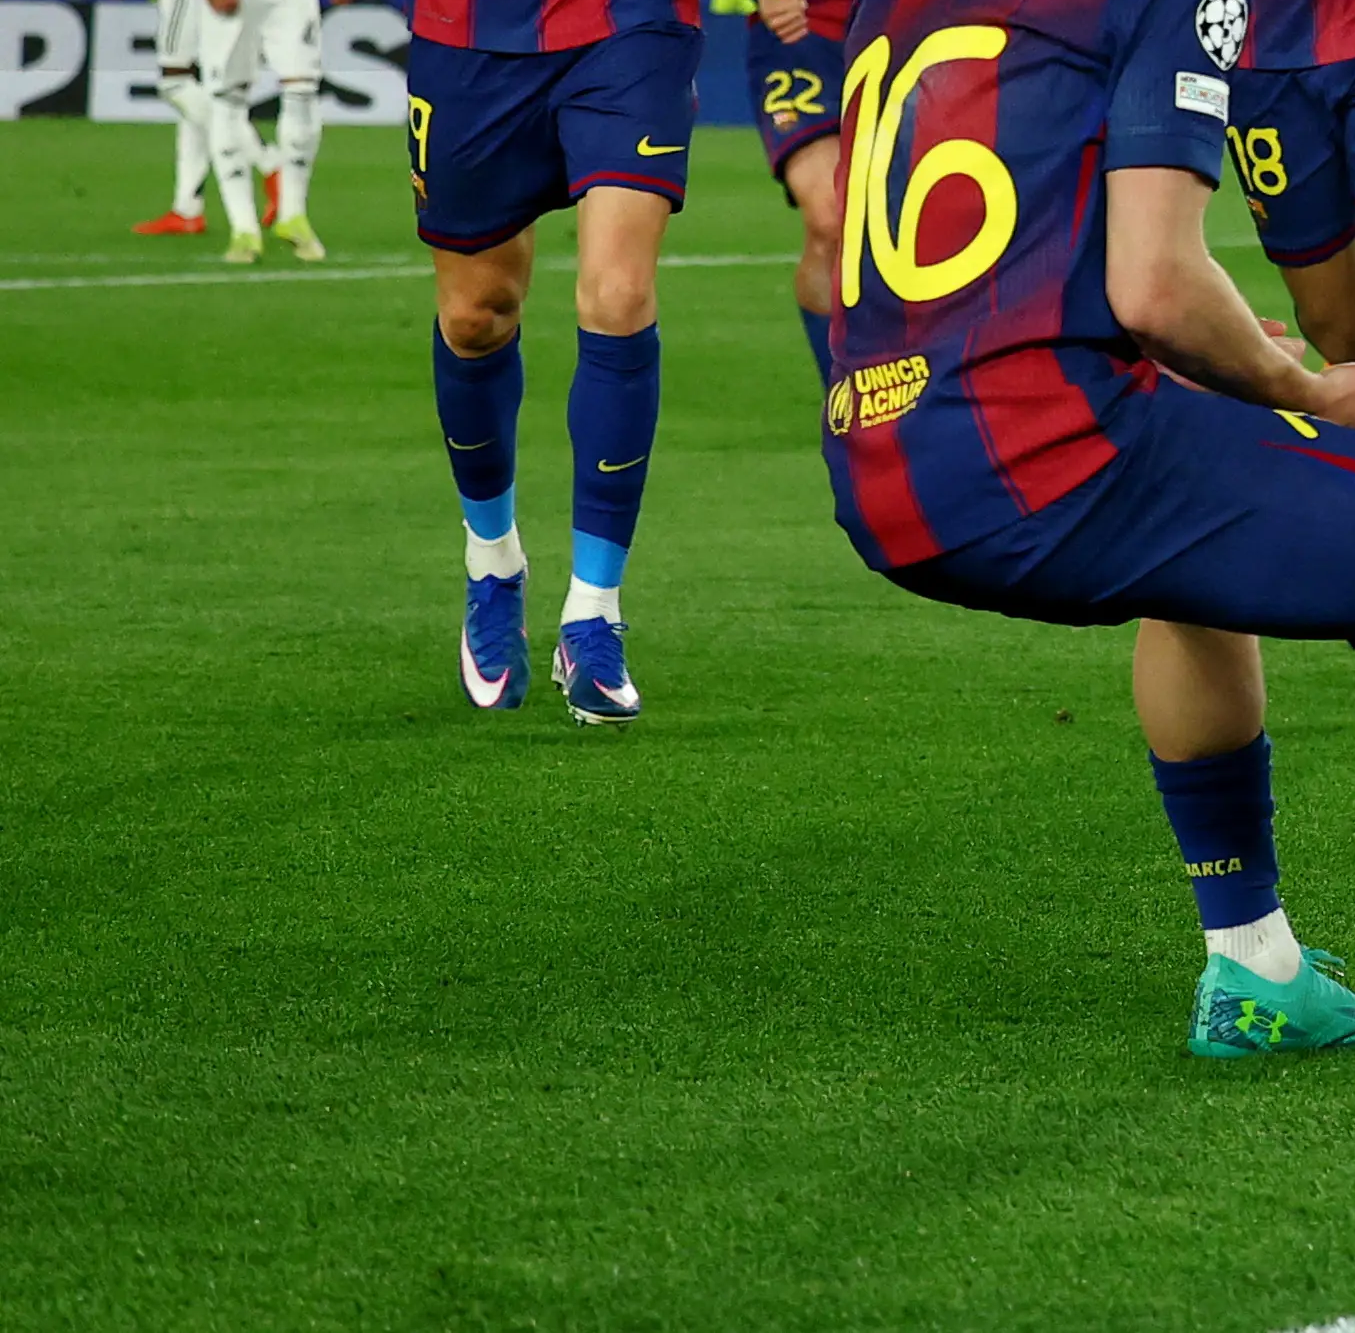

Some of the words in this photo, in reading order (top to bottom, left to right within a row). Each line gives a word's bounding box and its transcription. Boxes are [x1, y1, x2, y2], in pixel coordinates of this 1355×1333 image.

[762, 69, 827, 115] 22
[838, 24, 1018, 309] 16
[1226, 125, 1288, 196] 18
[854, 355, 931, 394] UNHCR
[859, 378, 928, 419] ACNUR
